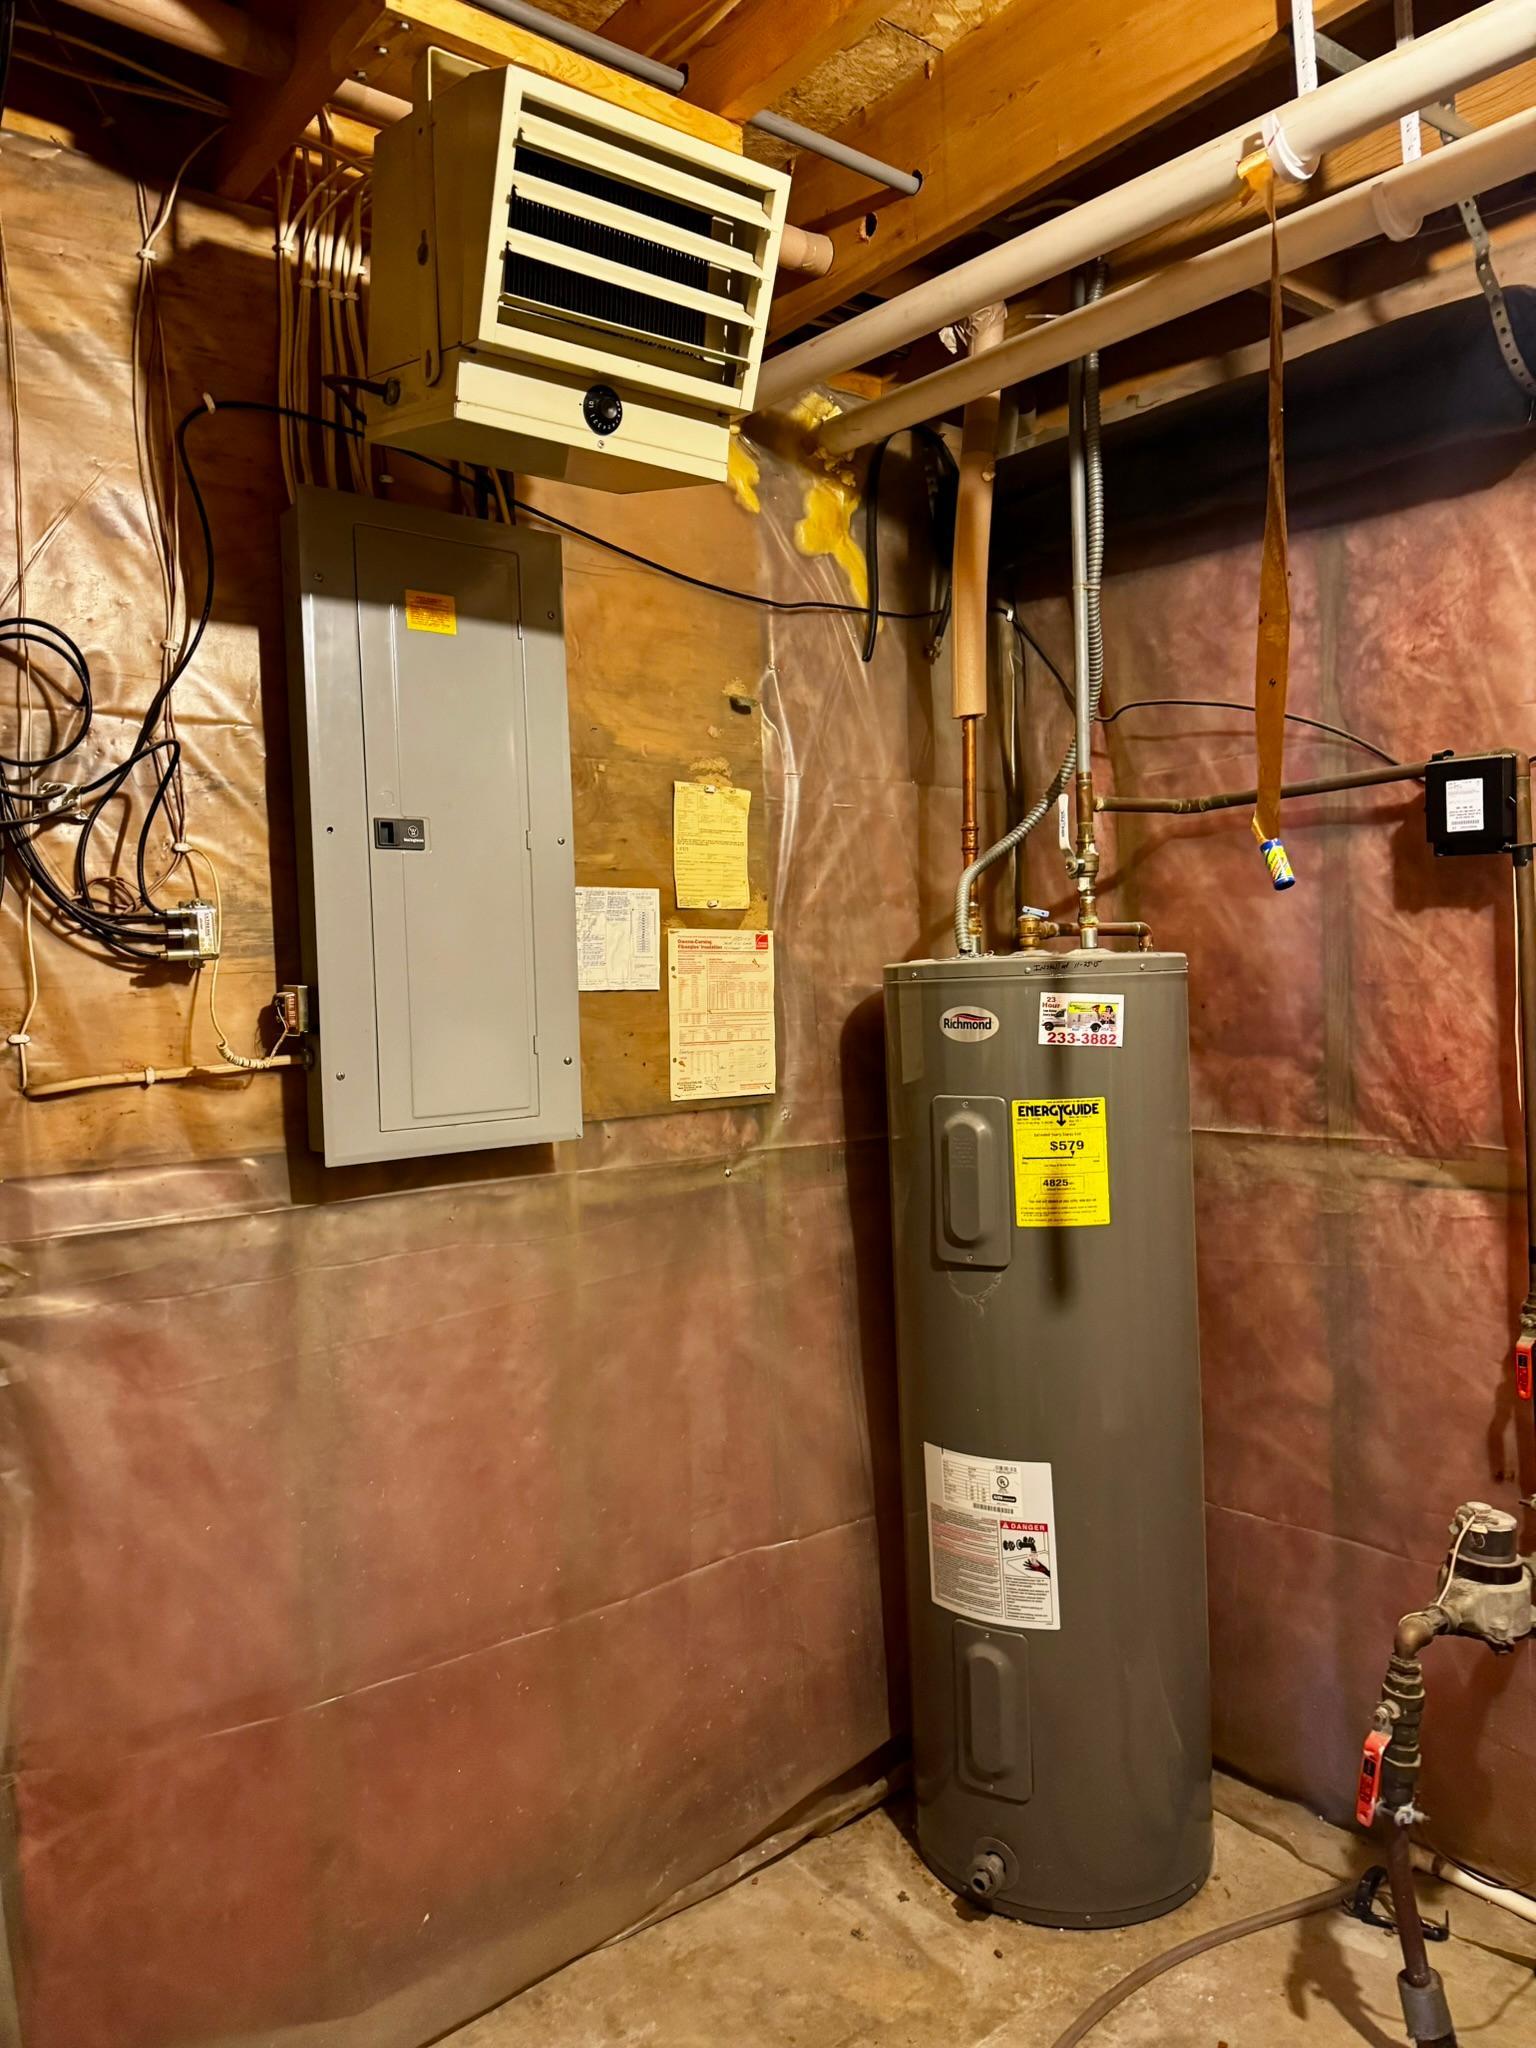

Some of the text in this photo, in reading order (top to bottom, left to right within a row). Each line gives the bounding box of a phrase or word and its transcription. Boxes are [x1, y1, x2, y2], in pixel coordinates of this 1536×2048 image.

[944, 1016, 992, 1029] Richmond
[1048, 1032, 1117, 1045] 233-3882
[1050, 1140, 1084, 1151] $579
[1043, 1179, 1069, 1187] 4825
[1010, 1523, 1045, 1531] DANGER
